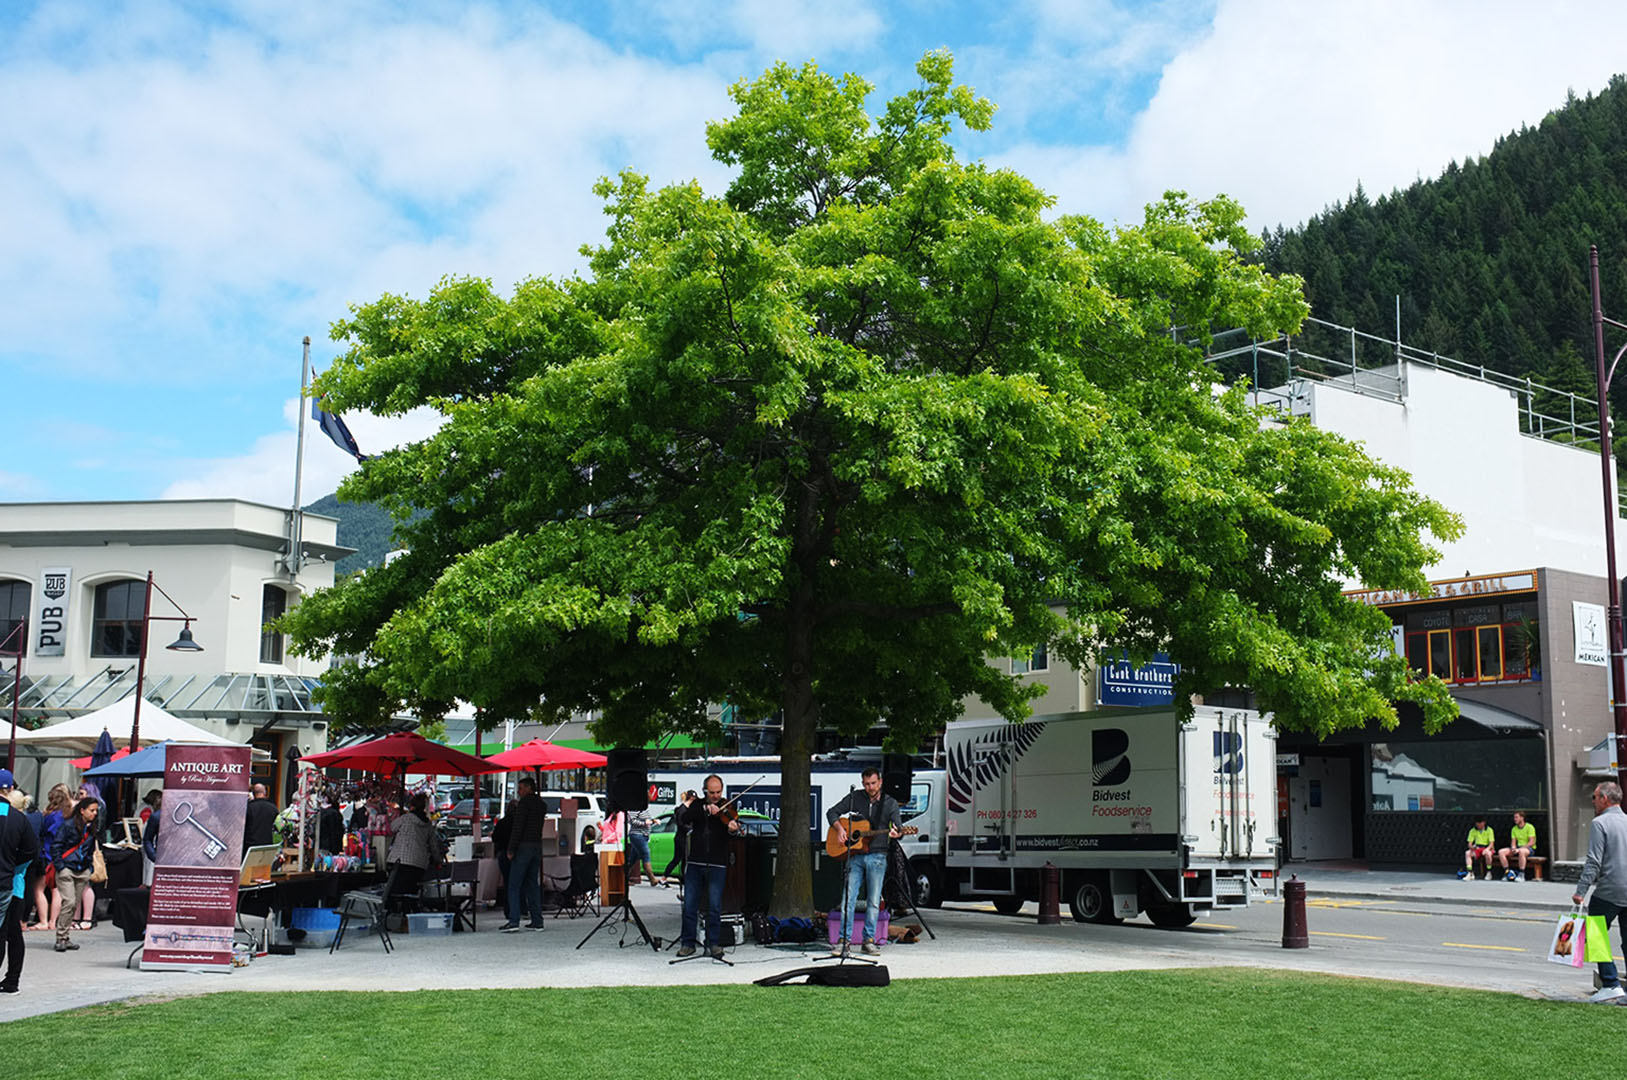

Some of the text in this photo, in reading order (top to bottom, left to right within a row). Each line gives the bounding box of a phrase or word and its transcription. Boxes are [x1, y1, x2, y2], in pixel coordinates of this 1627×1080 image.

[1445, 584, 1456, 596] &
[1460, 577, 1507, 594] GRILL
[40, 606, 63, 648] PUB
[1578, 653, 1605, 663] MEXICAN
[1110, 686, 1173, 696] CONSTRUCTION
[170, 762, 244, 775] ANTIQUE ART
[657, 786, 674, 798] Gifts
[1092, 789, 1131, 801] Bidvest
[1091, 804, 1153, 816] Foodservice
